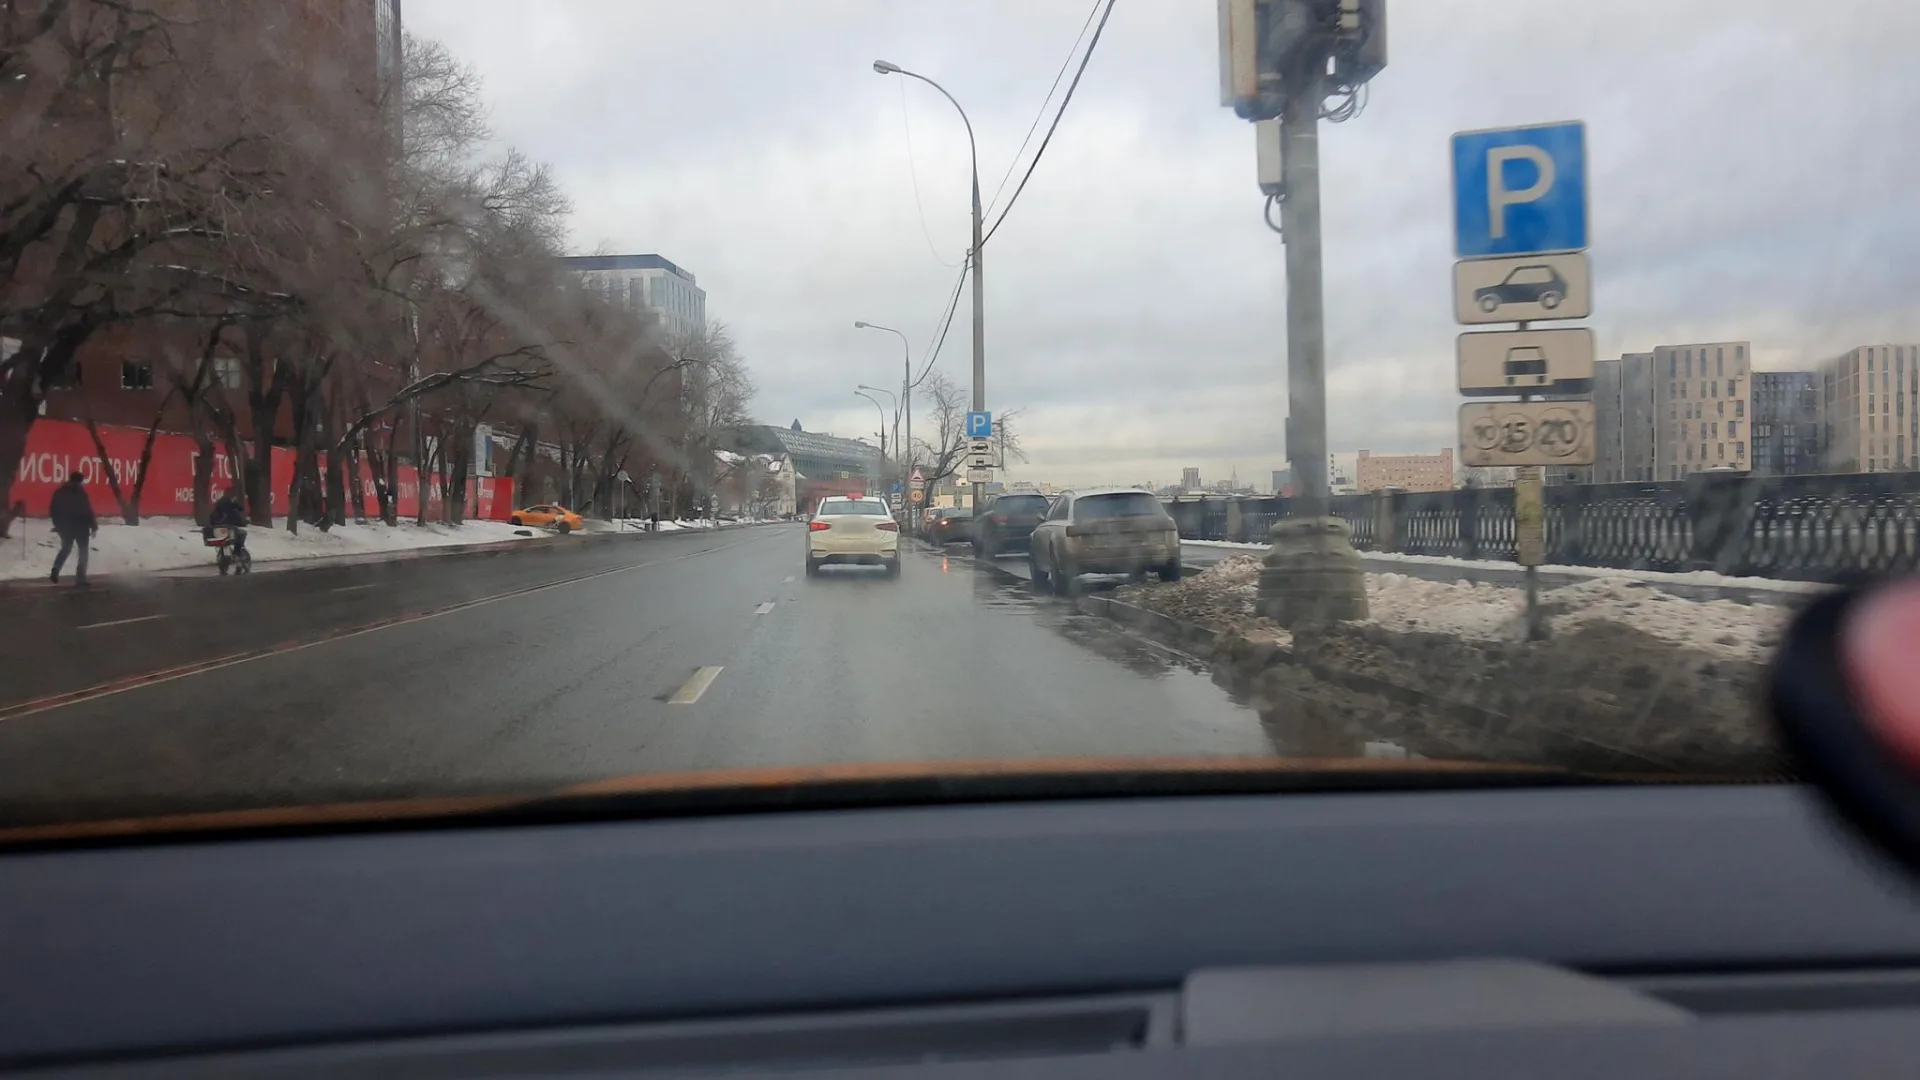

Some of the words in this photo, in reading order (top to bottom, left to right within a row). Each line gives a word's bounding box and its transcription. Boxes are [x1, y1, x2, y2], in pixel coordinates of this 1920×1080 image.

[1487, 145, 1556, 238] P
[973, 415, 985, 434] P
[1502, 421, 1527, 443] 15
[1541, 419, 1578, 444] 20
[20, 452, 70, 483] ИСЫ
[79, 456, 103, 485] ОТ
